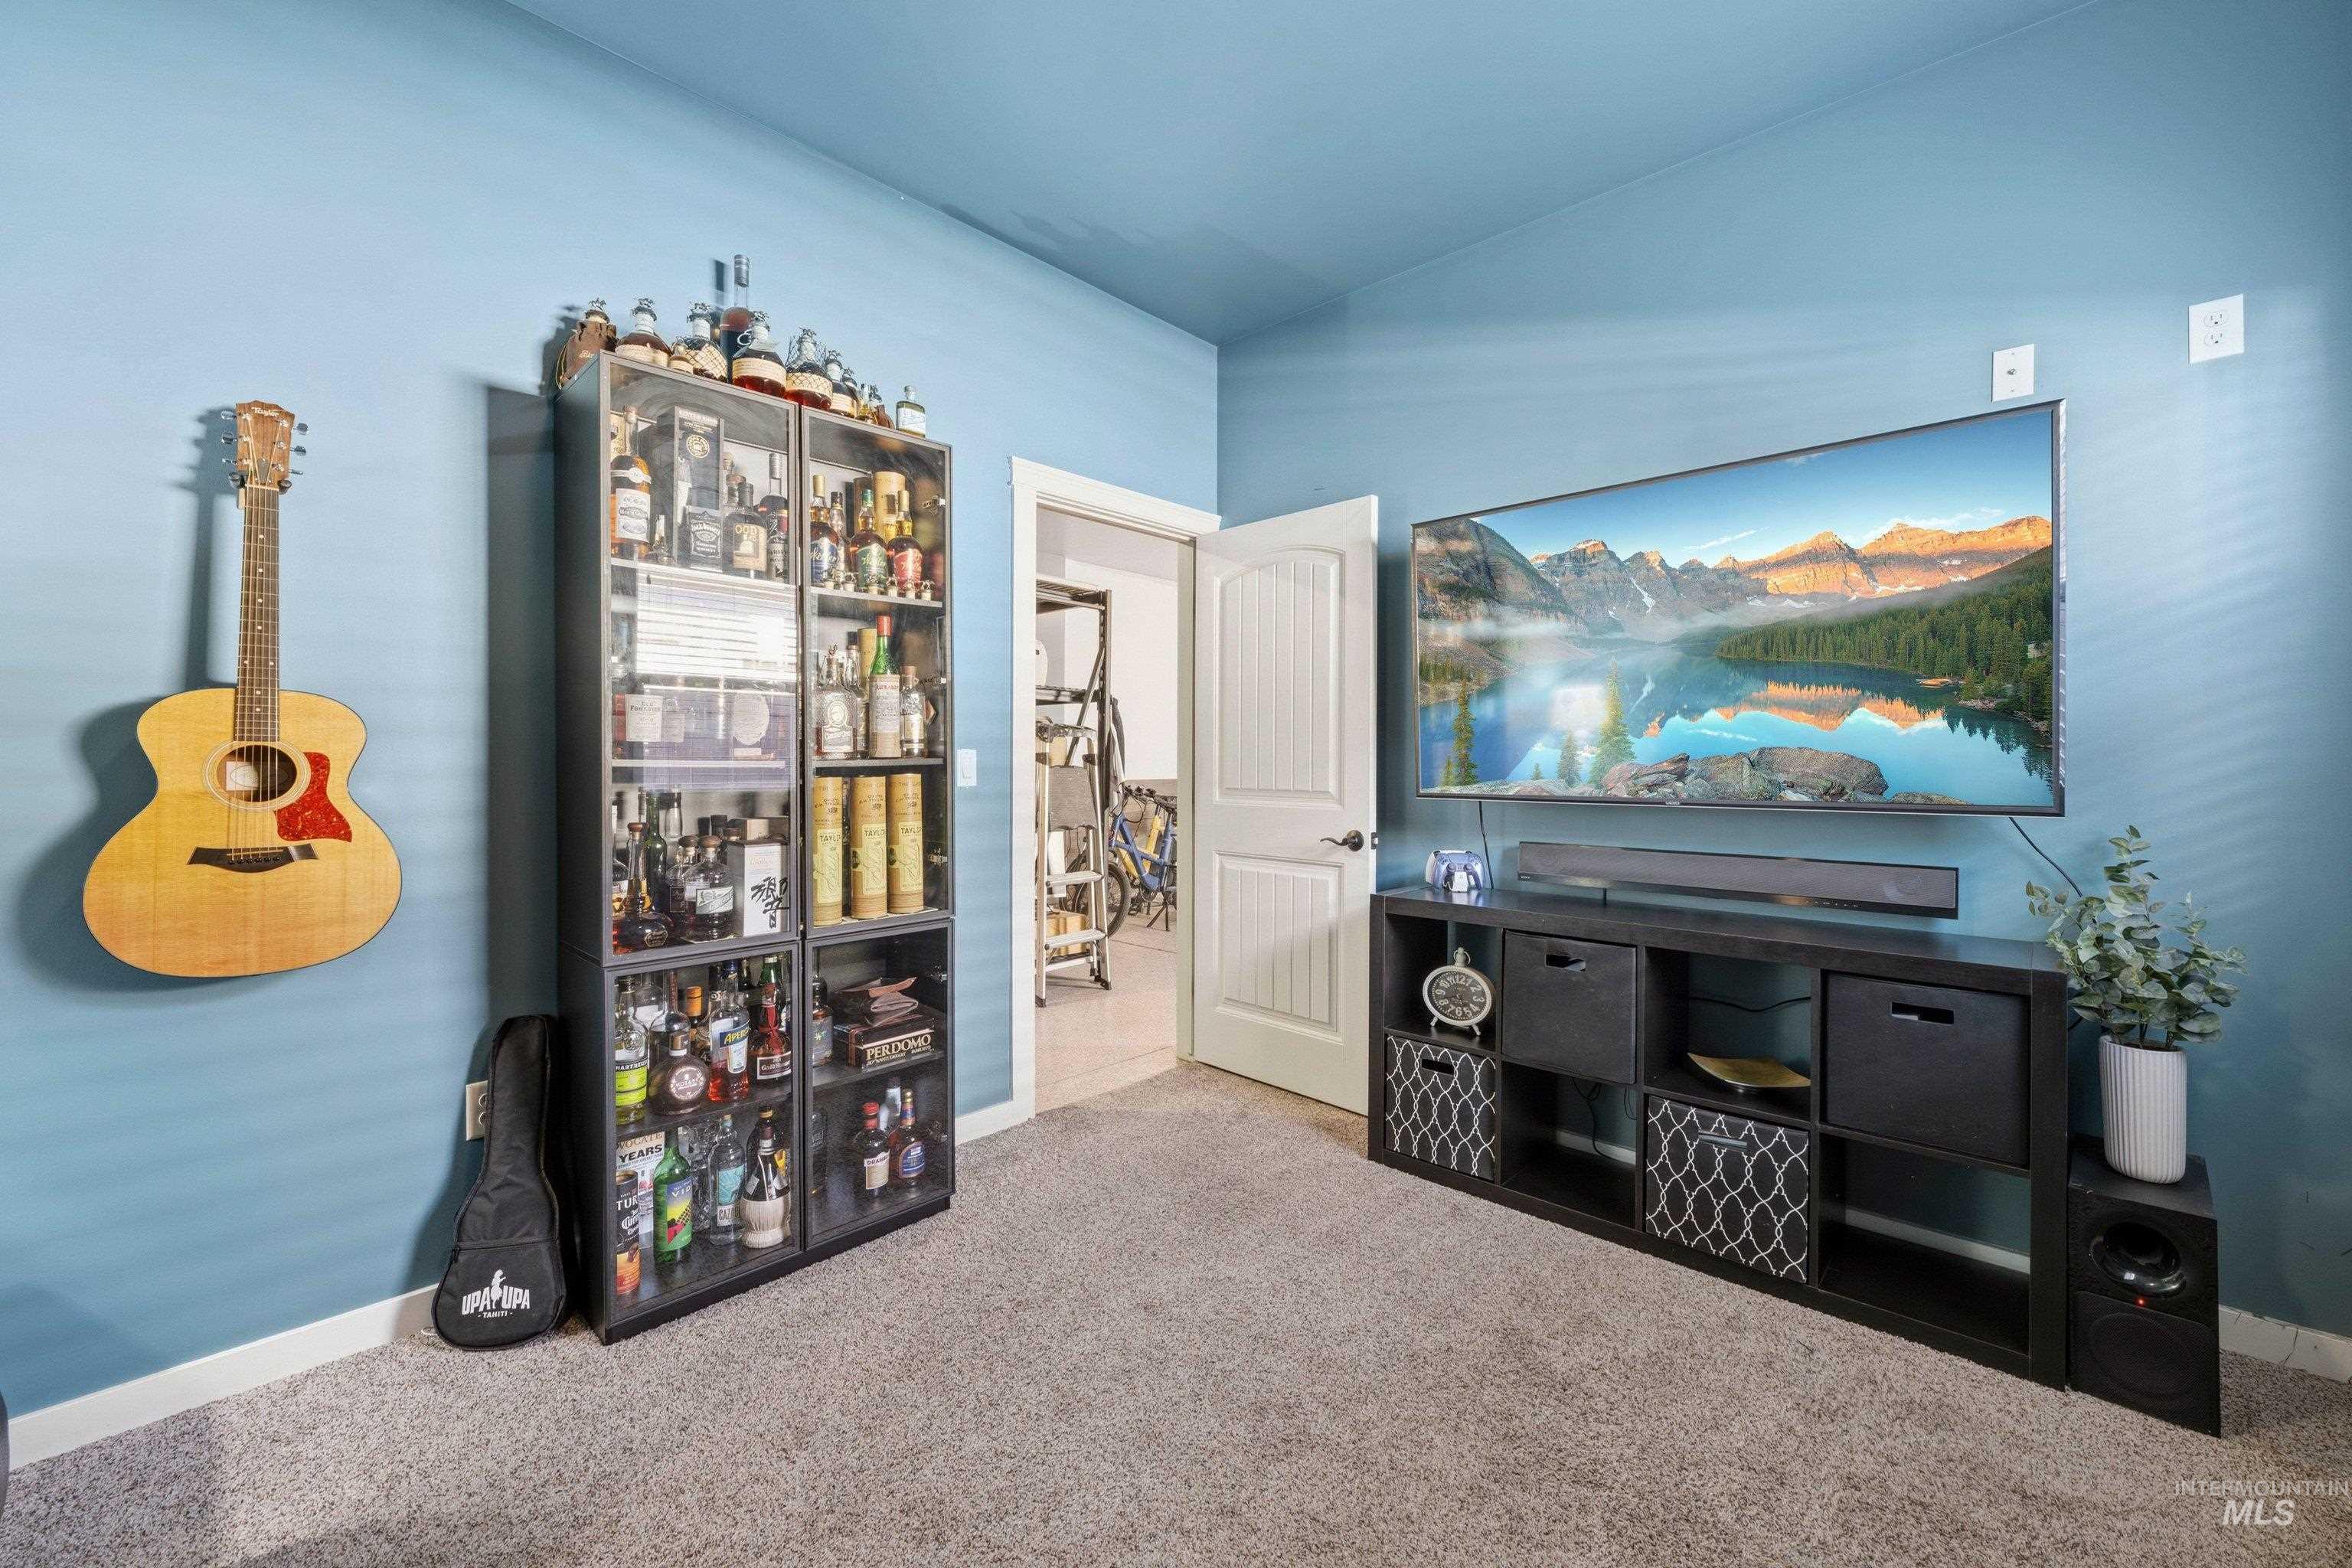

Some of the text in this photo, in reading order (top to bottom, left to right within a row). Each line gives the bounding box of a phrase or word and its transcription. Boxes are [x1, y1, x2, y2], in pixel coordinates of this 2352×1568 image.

[251, 407, 279, 417] Taylor
[866, 1034, 931, 1060] PERDOMO
[619, 1132, 663, 1149] VOCATE
[619, 1144, 663, 1165] YEARS
[671, 1184, 691, 1198] VID
[616, 1194, 639, 1210] TUR
[462, 1285, 531, 1315] UPA UPA
[482, 1310, 508, 1318] TAHITI
